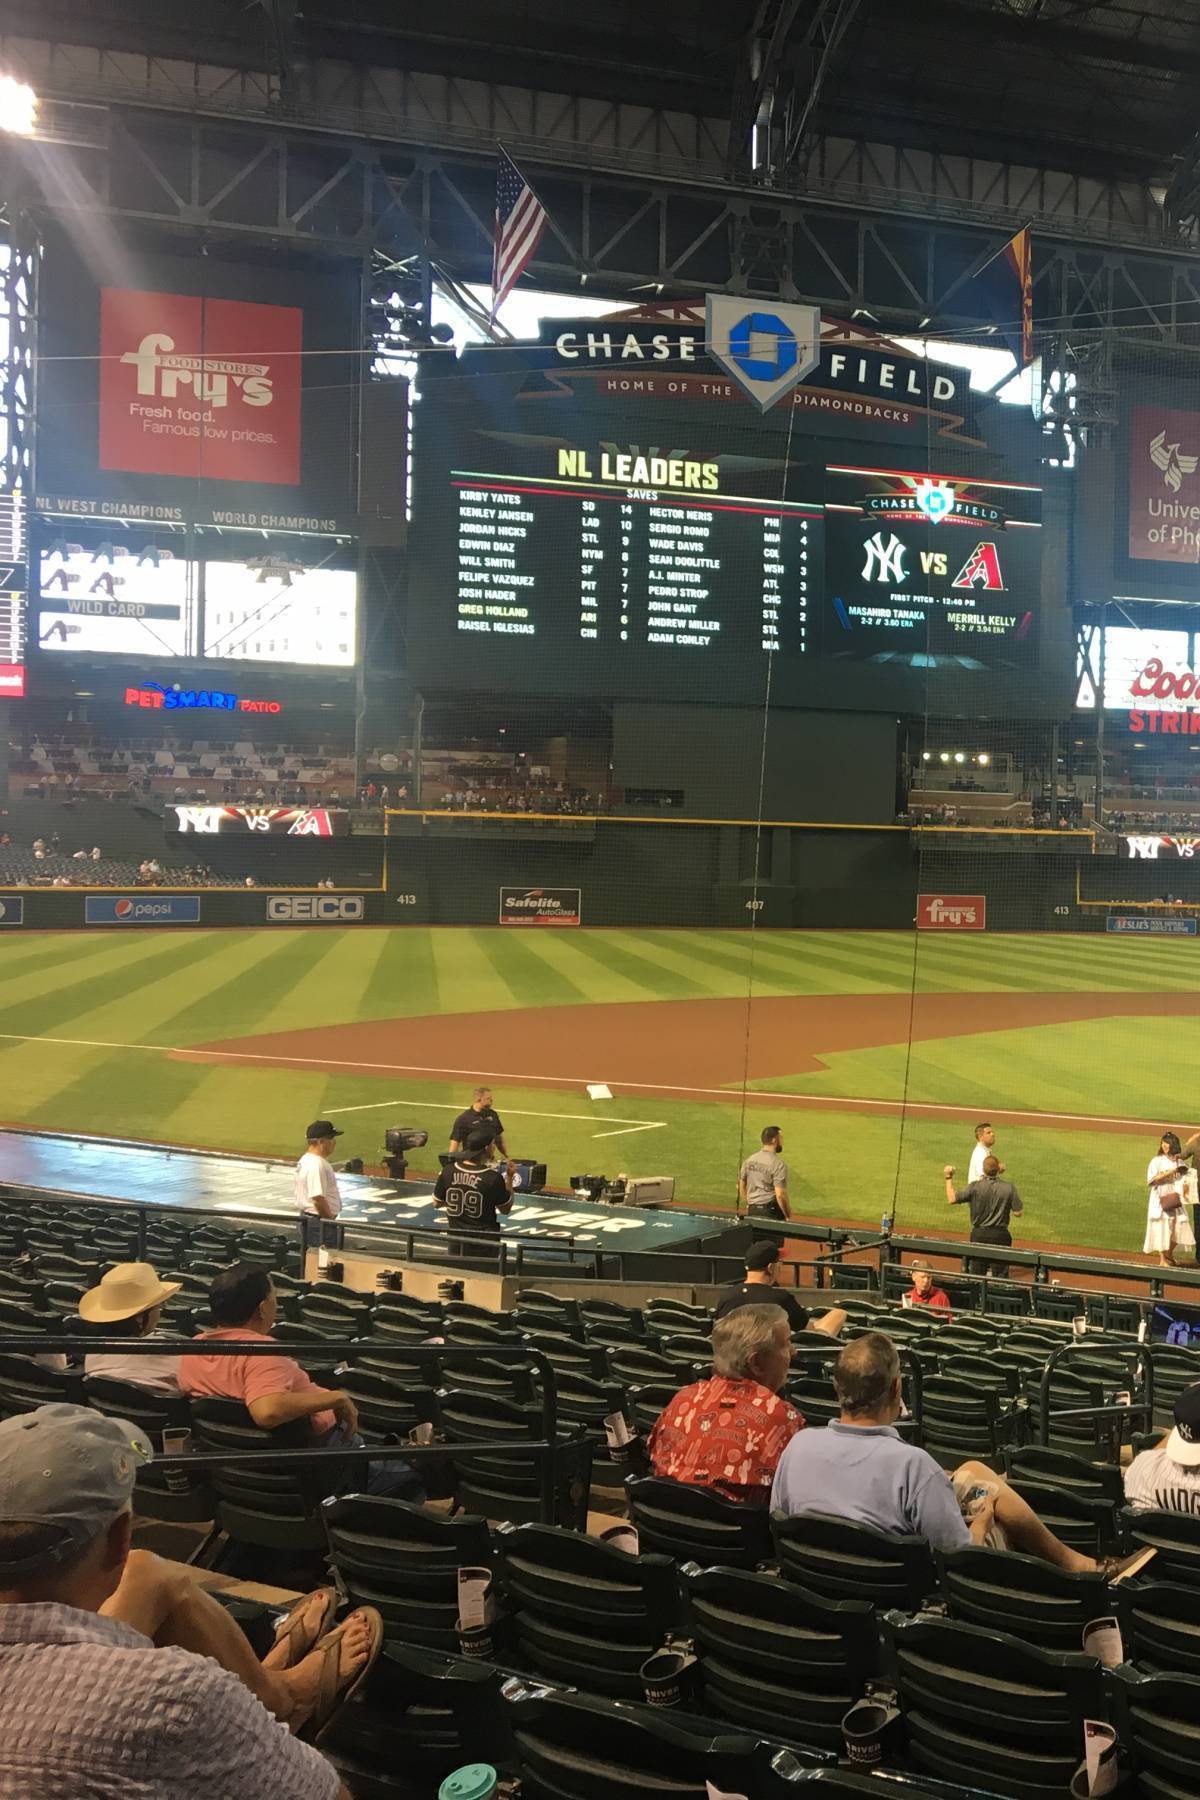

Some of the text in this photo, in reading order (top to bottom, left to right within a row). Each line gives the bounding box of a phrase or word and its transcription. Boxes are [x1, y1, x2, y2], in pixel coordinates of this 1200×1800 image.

[119, 332, 274, 408] fry's
[158, 355, 264, 376] FOOD STORES
[556, 333, 956, 401] CHASE FIELD
[607, 380, 910, 423] HOME OF THE DIAMONDBACKS
[130, 403, 216, 423] Fresh food.
[143, 420, 277, 444] Famous low prices.
[558, 449, 719, 490] NL LEADERS
[460, 490, 521, 504] KIRBY YATES
[626, 489, 658, 500] SAVES
[35, 498, 182, 520] NL WEST CHAMPIONS
[459, 507, 533, 522] KENLEY JANSEN
[649, 507, 713, 522] HECTOR NERIS
[871, 499, 998, 519] CHASE FIELD
[212, 511, 337, 532] WORLD CHAMPIONS
[459, 523, 526, 537] JORDAN HICKS
[649, 523, 709, 537] SERGIO ROMO
[1148, 525, 1168, 543] of
[459, 539, 515, 552] EDWIN DIAZ
[649, 538, 704, 552] WADE DAVIS
[459, 555, 515, 569] WILL SMITH
[648, 554, 720, 569] SEAN DOOLITTLE
[919, 551, 948, 575] VS
[458, 571, 535, 586] FELIPE VAZQUEZ
[648, 570, 701, 583] A.J. MINTER
[458, 588, 516, 601] JOSH HADER
[648, 586, 709, 599] PEDRO STROP
[67, 599, 145, 617] WILD CARD
[458, 604, 528, 618] GREG HOLLAND
[648, 601, 697, 614] JOHN GANT
[848, 606, 925, 620] MASAHIRO TANAKA
[458, 620, 535, 634] RAISEL IGLESIAS
[648, 617, 720, 631] ANDREW MILLER
[901, 620, 914, 628] ERA
[947, 612, 1017, 627] MERRILL KELLY
[993, 626, 1005, 634] ERA
[648, 632, 710, 646] ADAM CONLEY
[239, 700, 281, 713] PATIO
[244, 815, 270, 831] VS
[1176, 841, 1194, 858] VS
[396, 894, 416, 905] 413
[504, 897, 561, 908] Safelite
[745, 900, 764, 910] 407
[135, 902, 172, 918] pepsi
[268, 899, 362, 919] GEICO
[535, 908, 576, 916] AutoGlass
[926, 898, 977, 925] fry's
[1054, 906, 1070, 915] 413
[451, 1172, 482, 1190] JUDGE
[445, 1187, 483, 1218] 99
